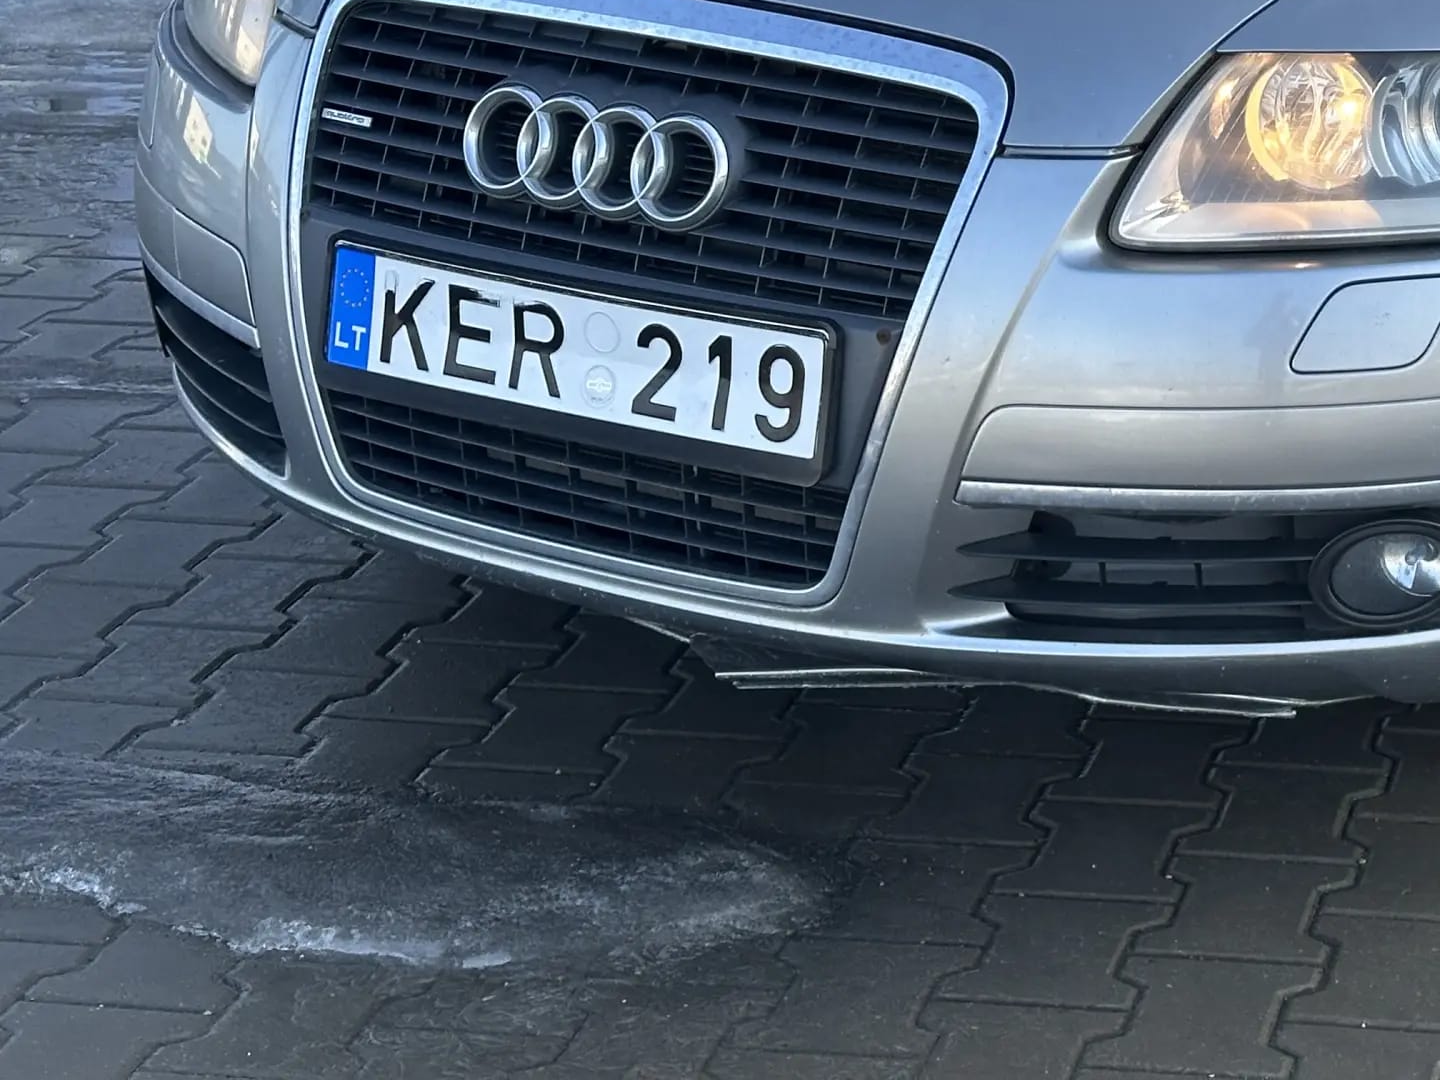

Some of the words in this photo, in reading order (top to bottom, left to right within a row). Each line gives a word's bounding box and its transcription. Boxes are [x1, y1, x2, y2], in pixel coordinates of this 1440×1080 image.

[333, 321, 367, 352] LT
[379, 273, 565, 399] KER
[631, 322, 806, 443] 219
